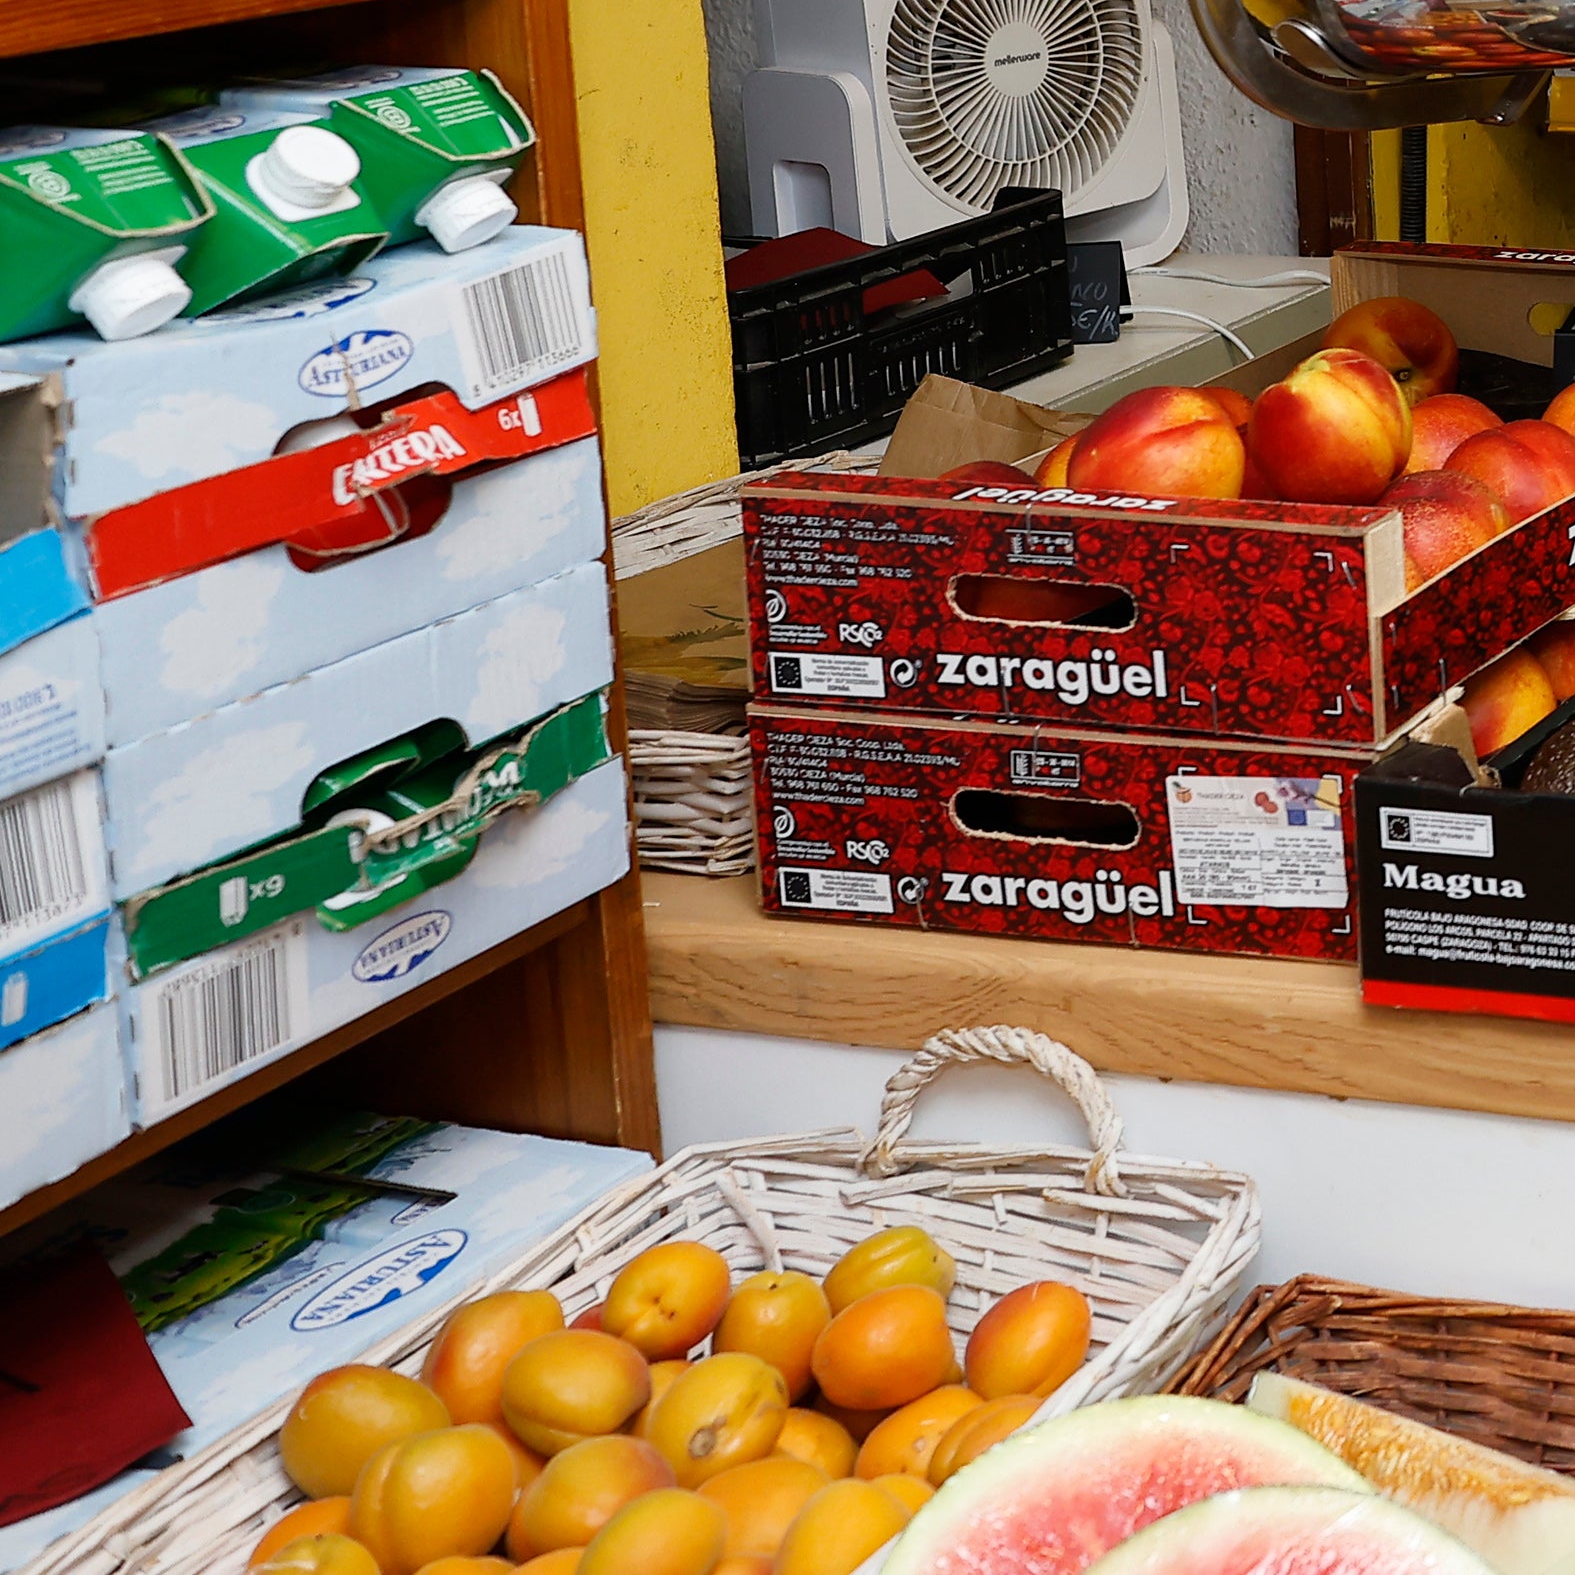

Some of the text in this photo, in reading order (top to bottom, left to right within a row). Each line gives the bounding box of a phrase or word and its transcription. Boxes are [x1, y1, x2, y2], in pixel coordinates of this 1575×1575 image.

[993, 48, 1041, 67] mellerware
[952, 485, 1178, 513] zaragüel
[936, 648, 1170, 707] zaragüel
[940, 868, 1175, 926] zaragüel
[1381, 862, 1527, 900] Magua
[360, 920, 447, 972] ASTURIANA
[301, 1234, 457, 1324] ASTURIANA
